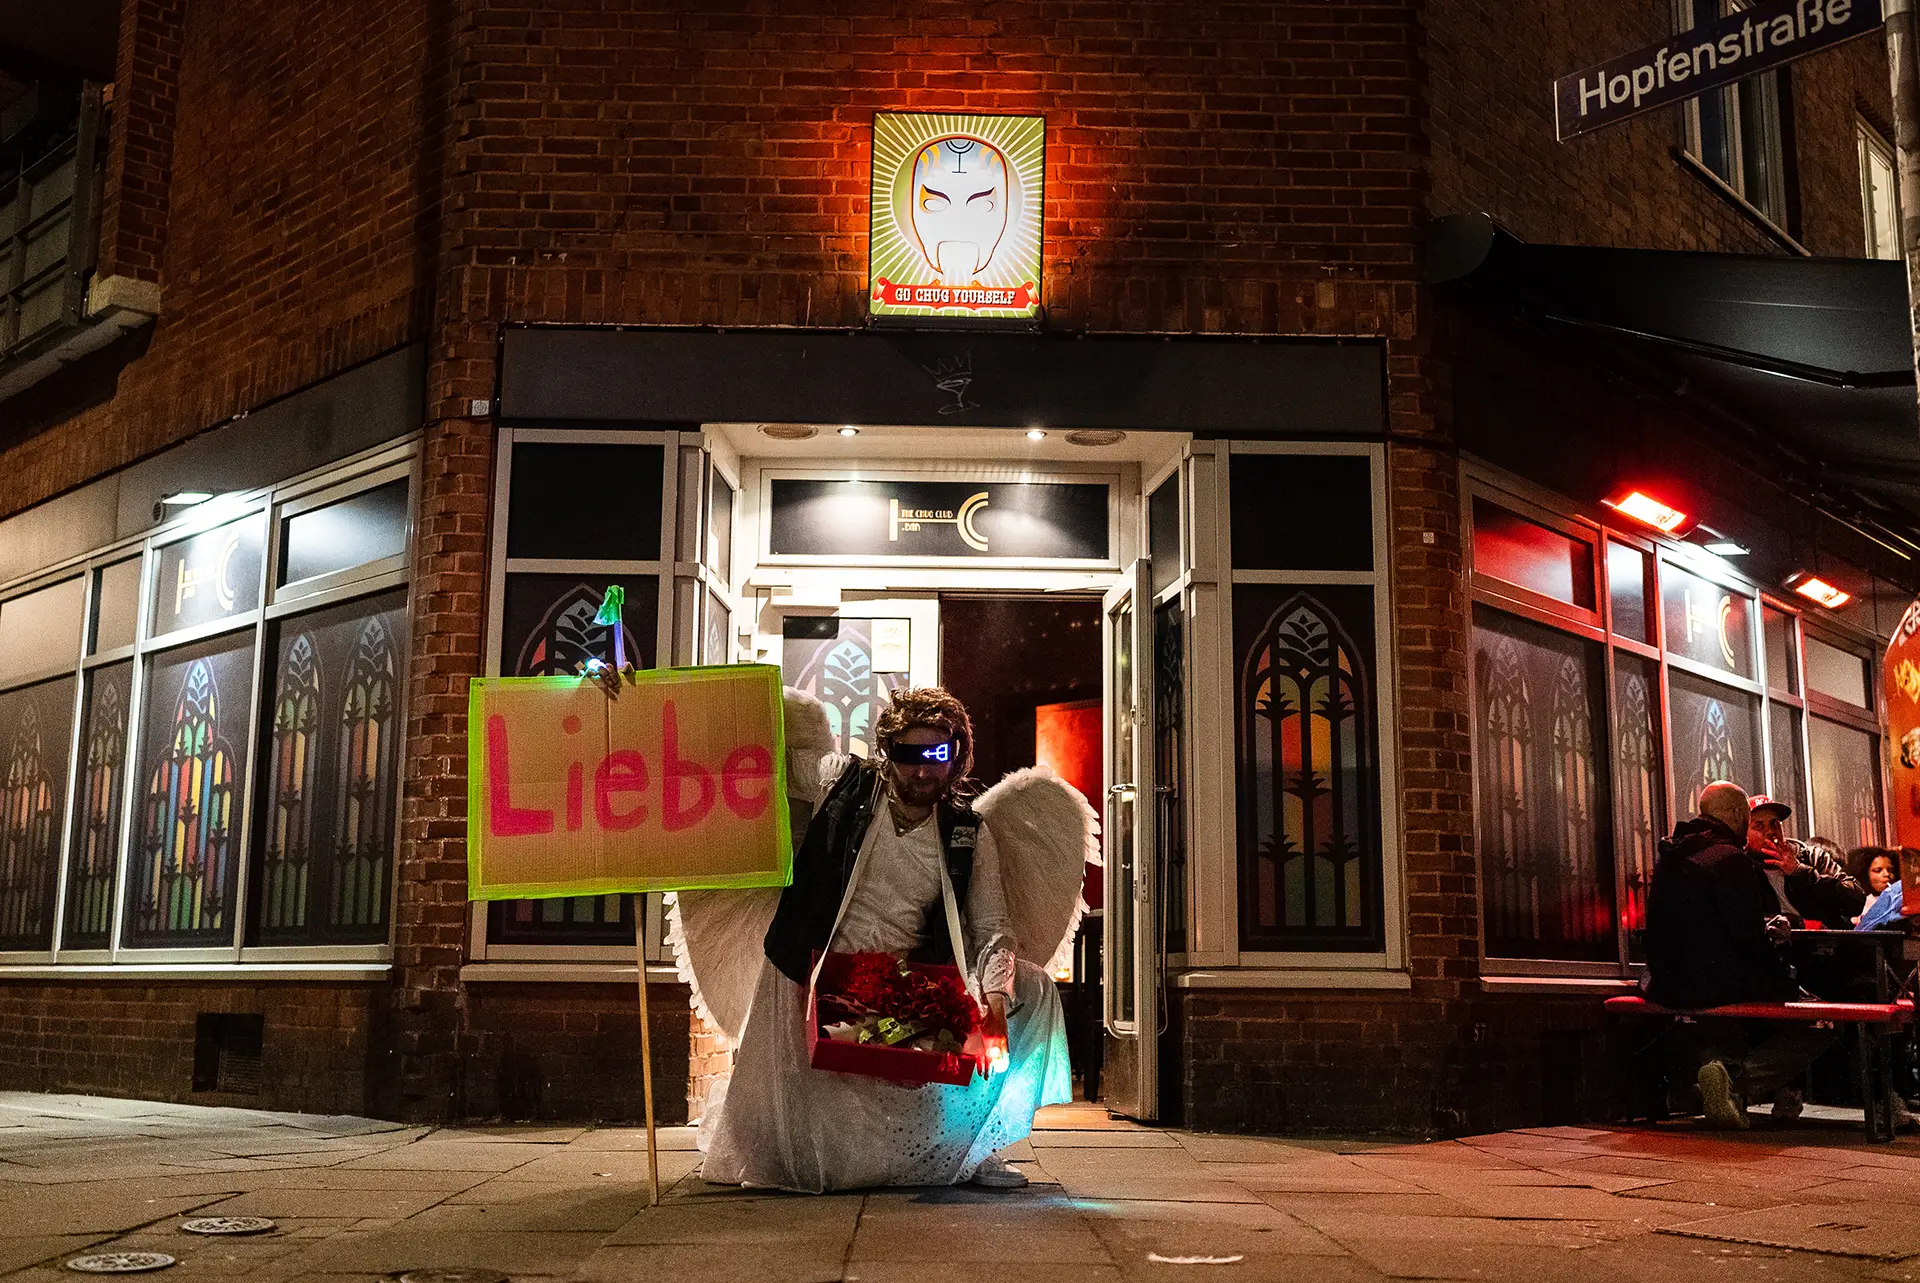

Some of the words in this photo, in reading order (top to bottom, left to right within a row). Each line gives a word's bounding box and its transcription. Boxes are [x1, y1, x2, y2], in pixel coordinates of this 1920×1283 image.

[1579, 0, 1851, 117] Hopfenstraße
[895, 287, 911, 302] GO
[915, 288, 950, 303] CHUG
[953, 289, 1016, 305] YOURSELF
[901, 509, 914, 518] THE
[915, 509, 934, 519] CHUG
[935, 509, 954, 519] CLUB
[487, 698, 773, 837] Liebe
